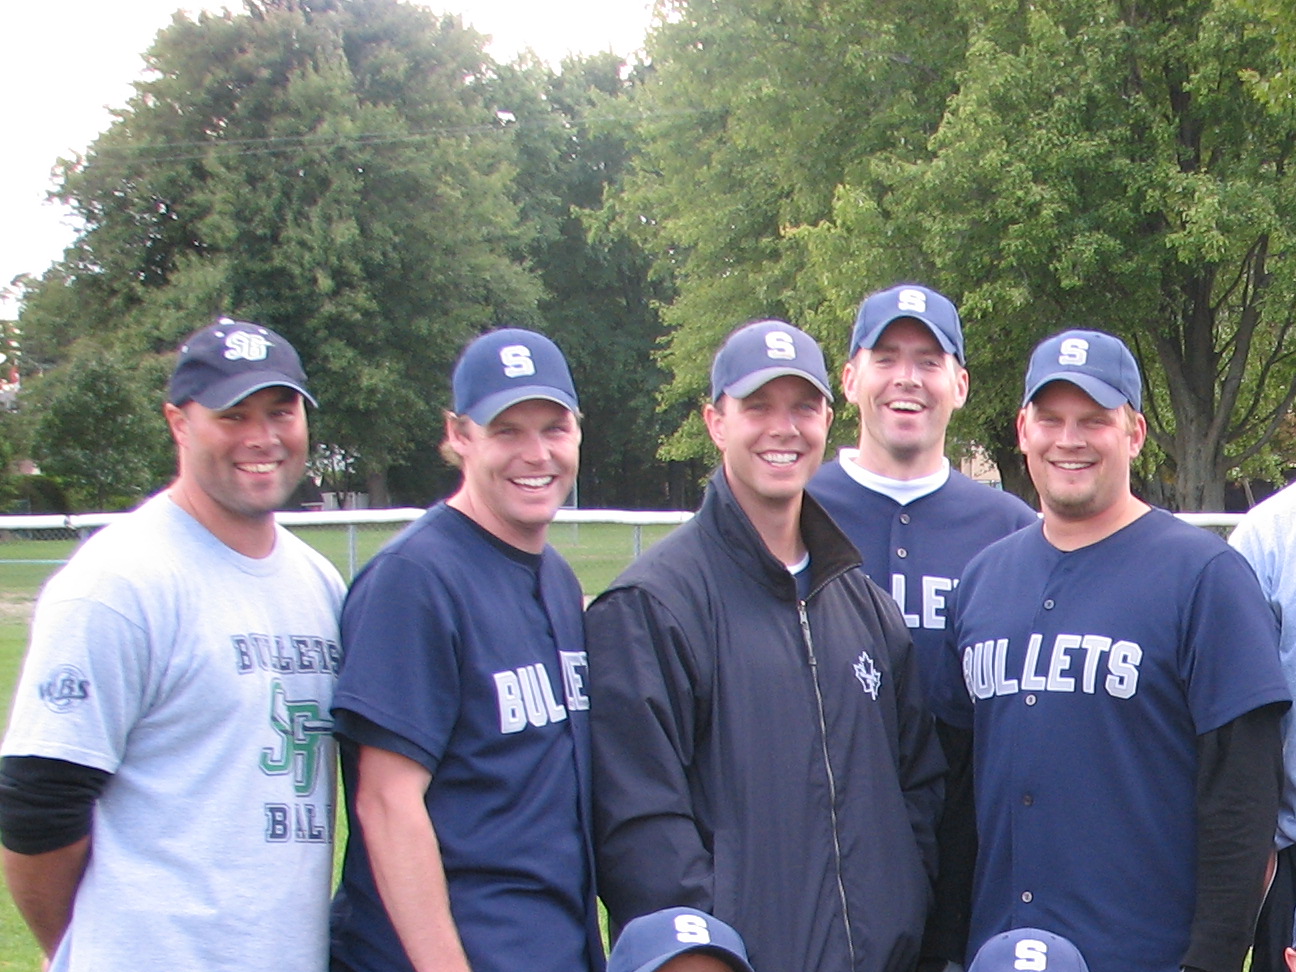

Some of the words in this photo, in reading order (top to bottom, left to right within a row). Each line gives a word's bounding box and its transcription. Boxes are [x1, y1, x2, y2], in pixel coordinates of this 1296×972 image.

[898, 289, 926, 313] S
[500, 345, 534, 377] S
[765, 331, 796, 360] S
[1059, 338, 1088, 365] S
[892, 573, 959, 629] LE
[231, 633, 340, 679] BULETS
[494, 651, 590, 734] BULLE
[674, 915, 710, 944] S
[1015, 940, 1046, 971] S
